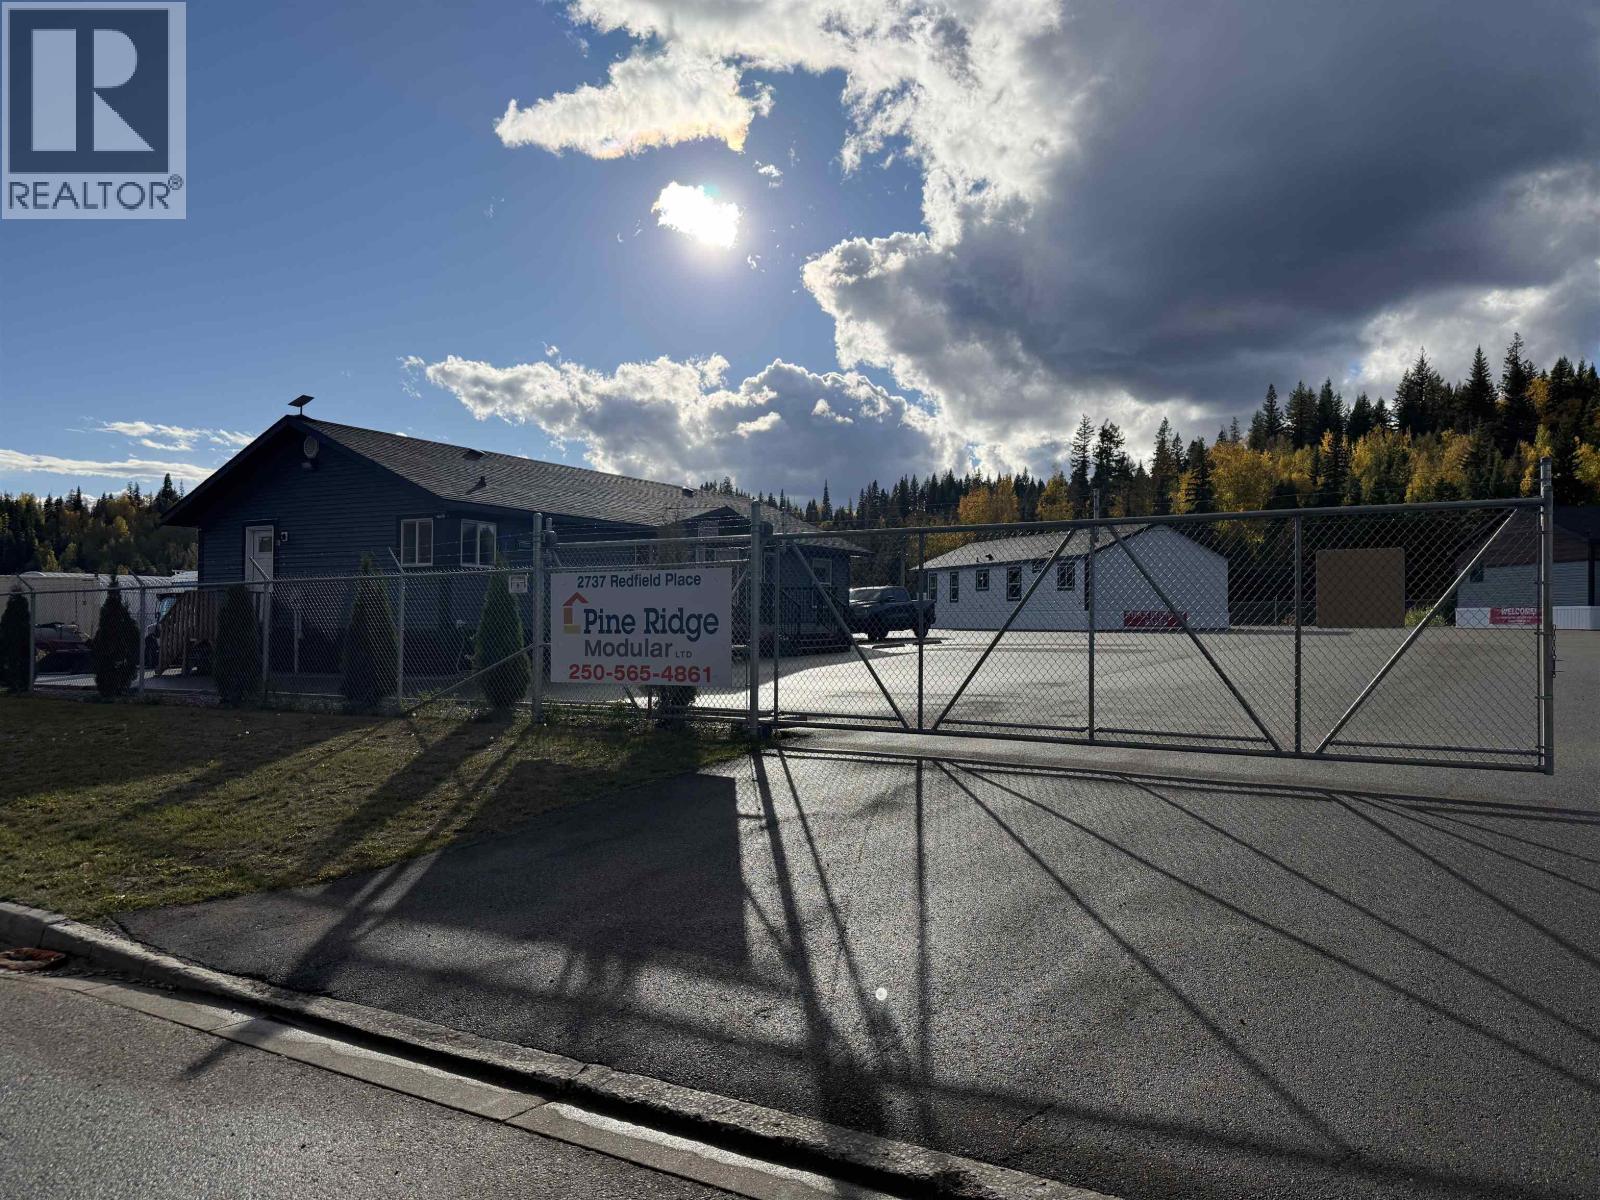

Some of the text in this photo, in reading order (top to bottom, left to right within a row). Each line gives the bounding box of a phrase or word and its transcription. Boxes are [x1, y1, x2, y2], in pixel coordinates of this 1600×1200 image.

[577, 572, 701, 589] 2737 Redfield Place
[583, 607, 719, 642] Pine Ridge
[585, 639, 693, 659] Modular LTD
[569, 664, 712, 683] 250-565-4861
